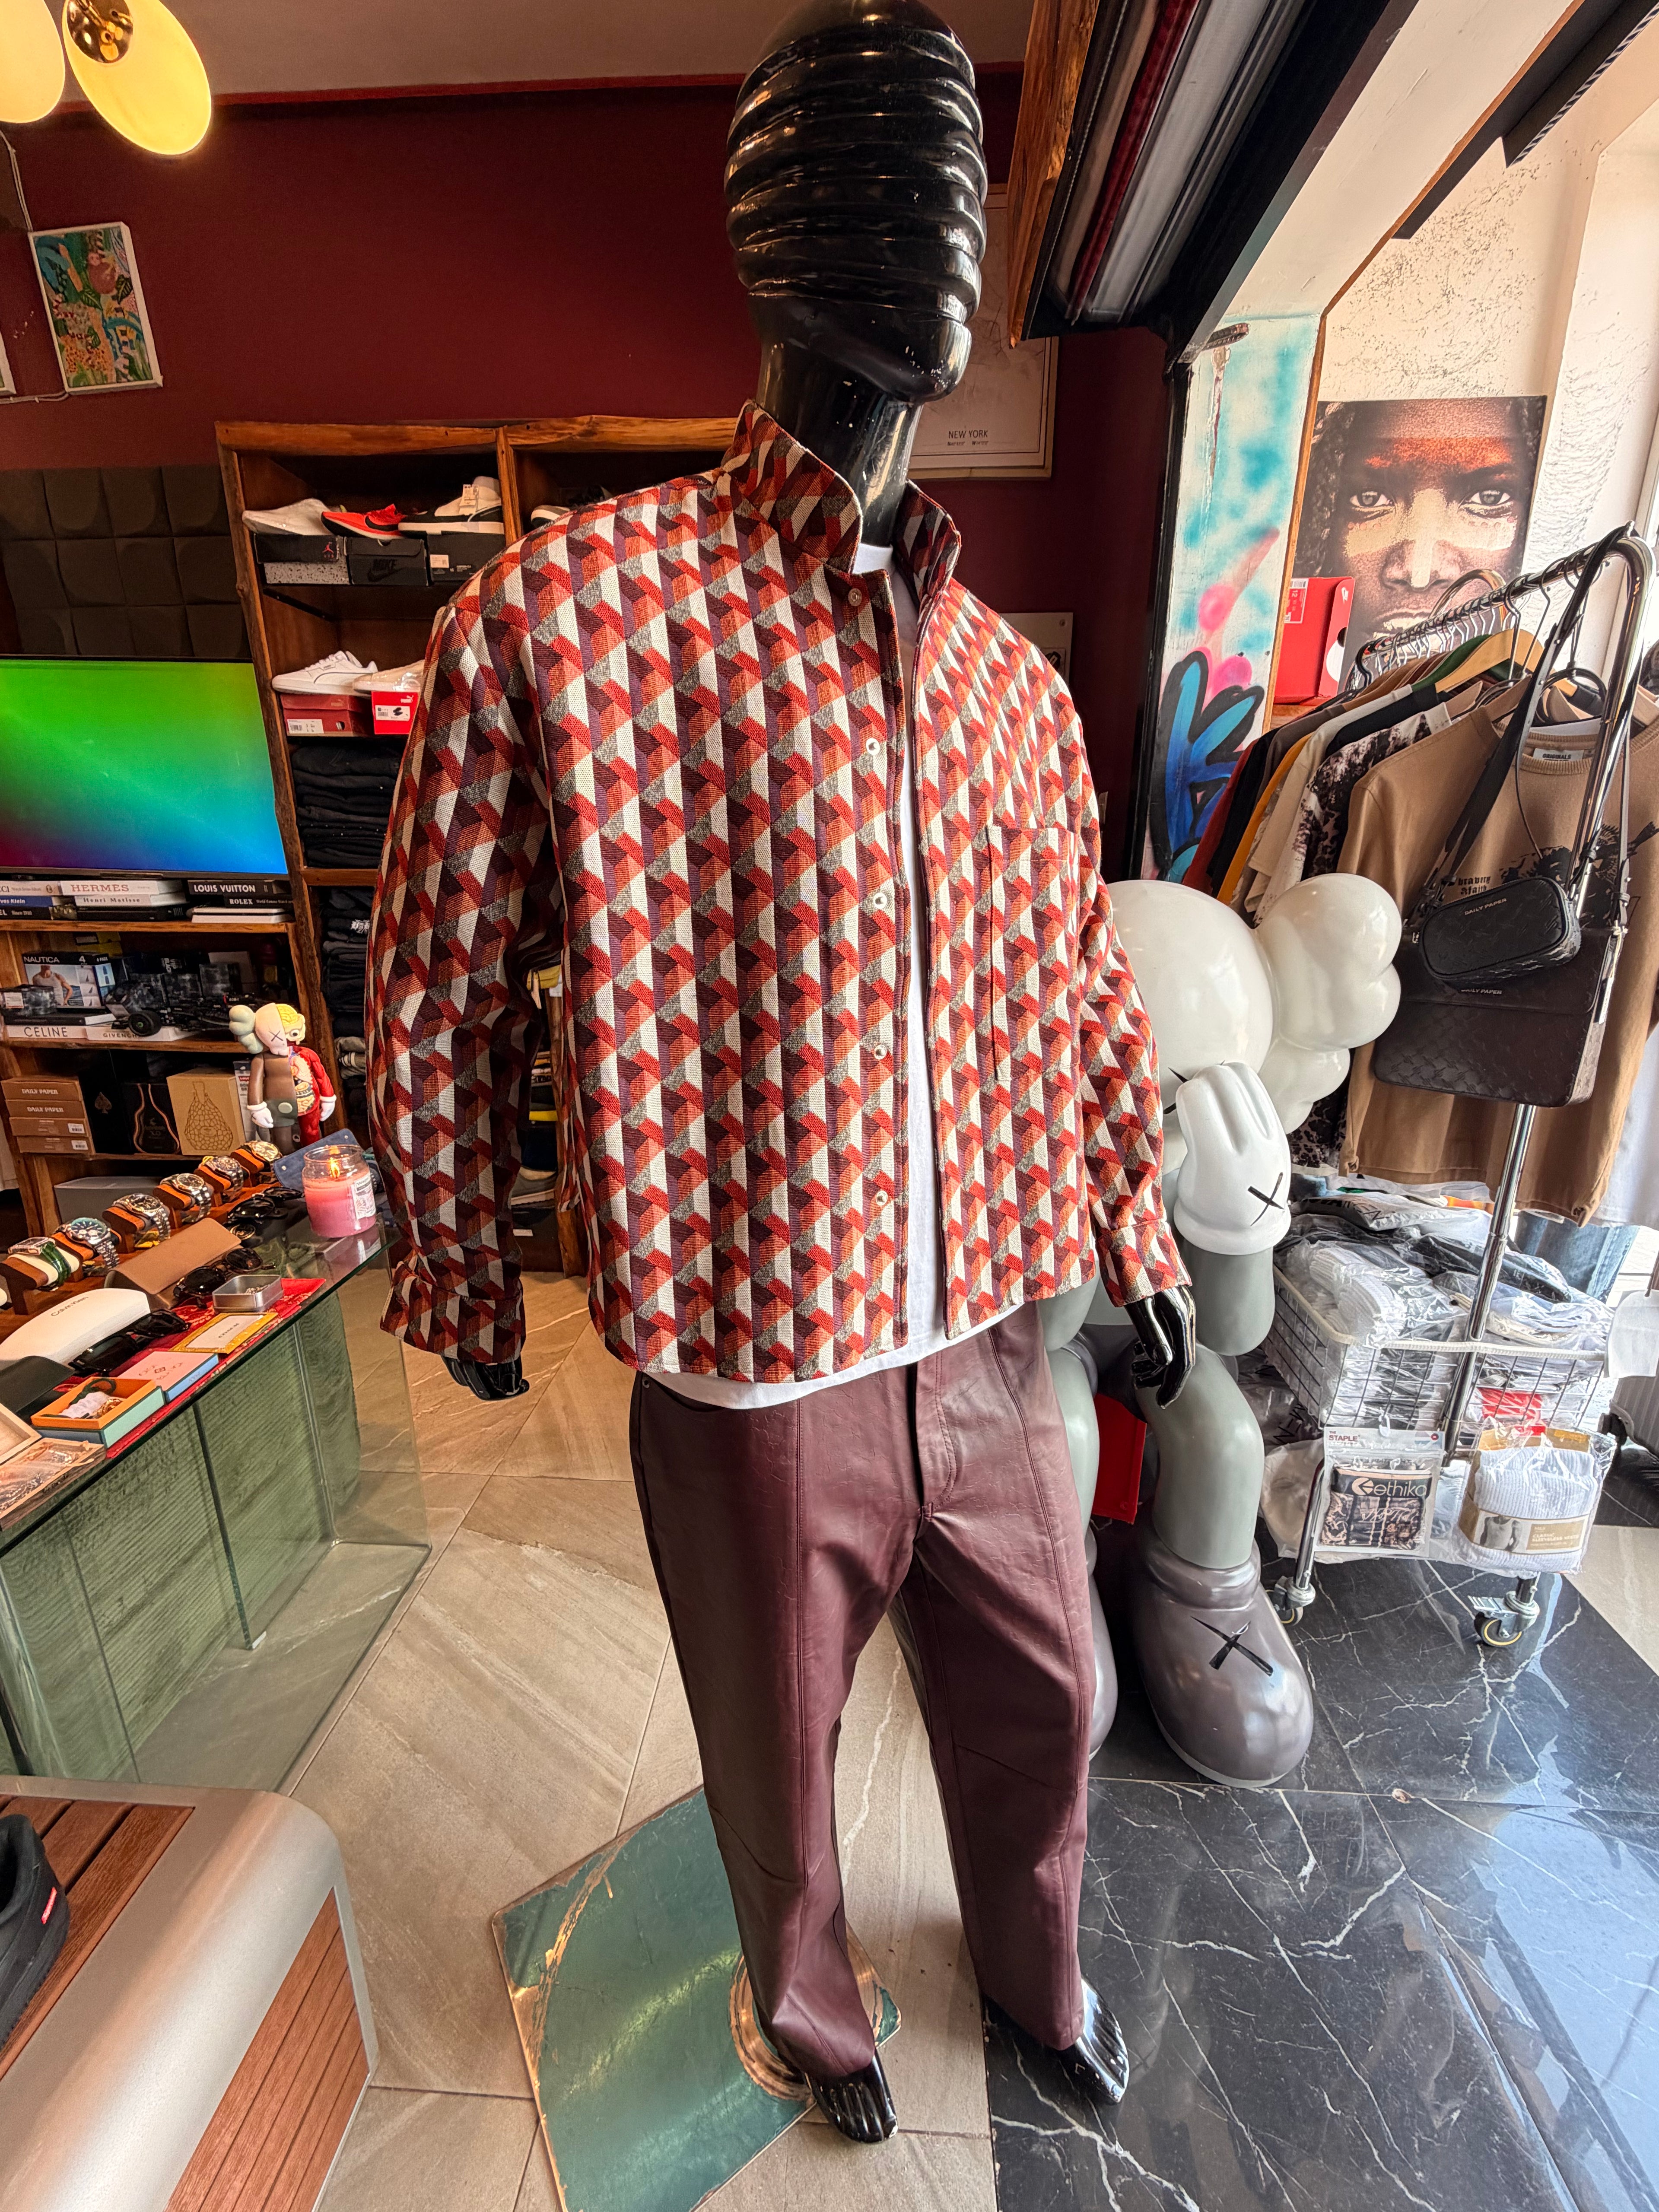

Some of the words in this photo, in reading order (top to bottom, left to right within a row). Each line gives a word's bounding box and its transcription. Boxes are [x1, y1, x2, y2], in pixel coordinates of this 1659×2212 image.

[948, 430, 966, 439] NEW
[969, 430, 988, 438] YORK
[70, 884, 130, 892] HERMES
[194, 884, 218, 893] LOUIS
[219, 885, 256, 893] VUITTON
[1465, 906, 1483, 915] DAILY
[1484, 898, 1507, 909] PAPER
[24, 1027, 68, 1037] CELINE
[51, 1303, 72, 1316] Calvin
[70, 1297, 89, 1306] Klein
[1373, 1480, 1427, 1497] ethika
